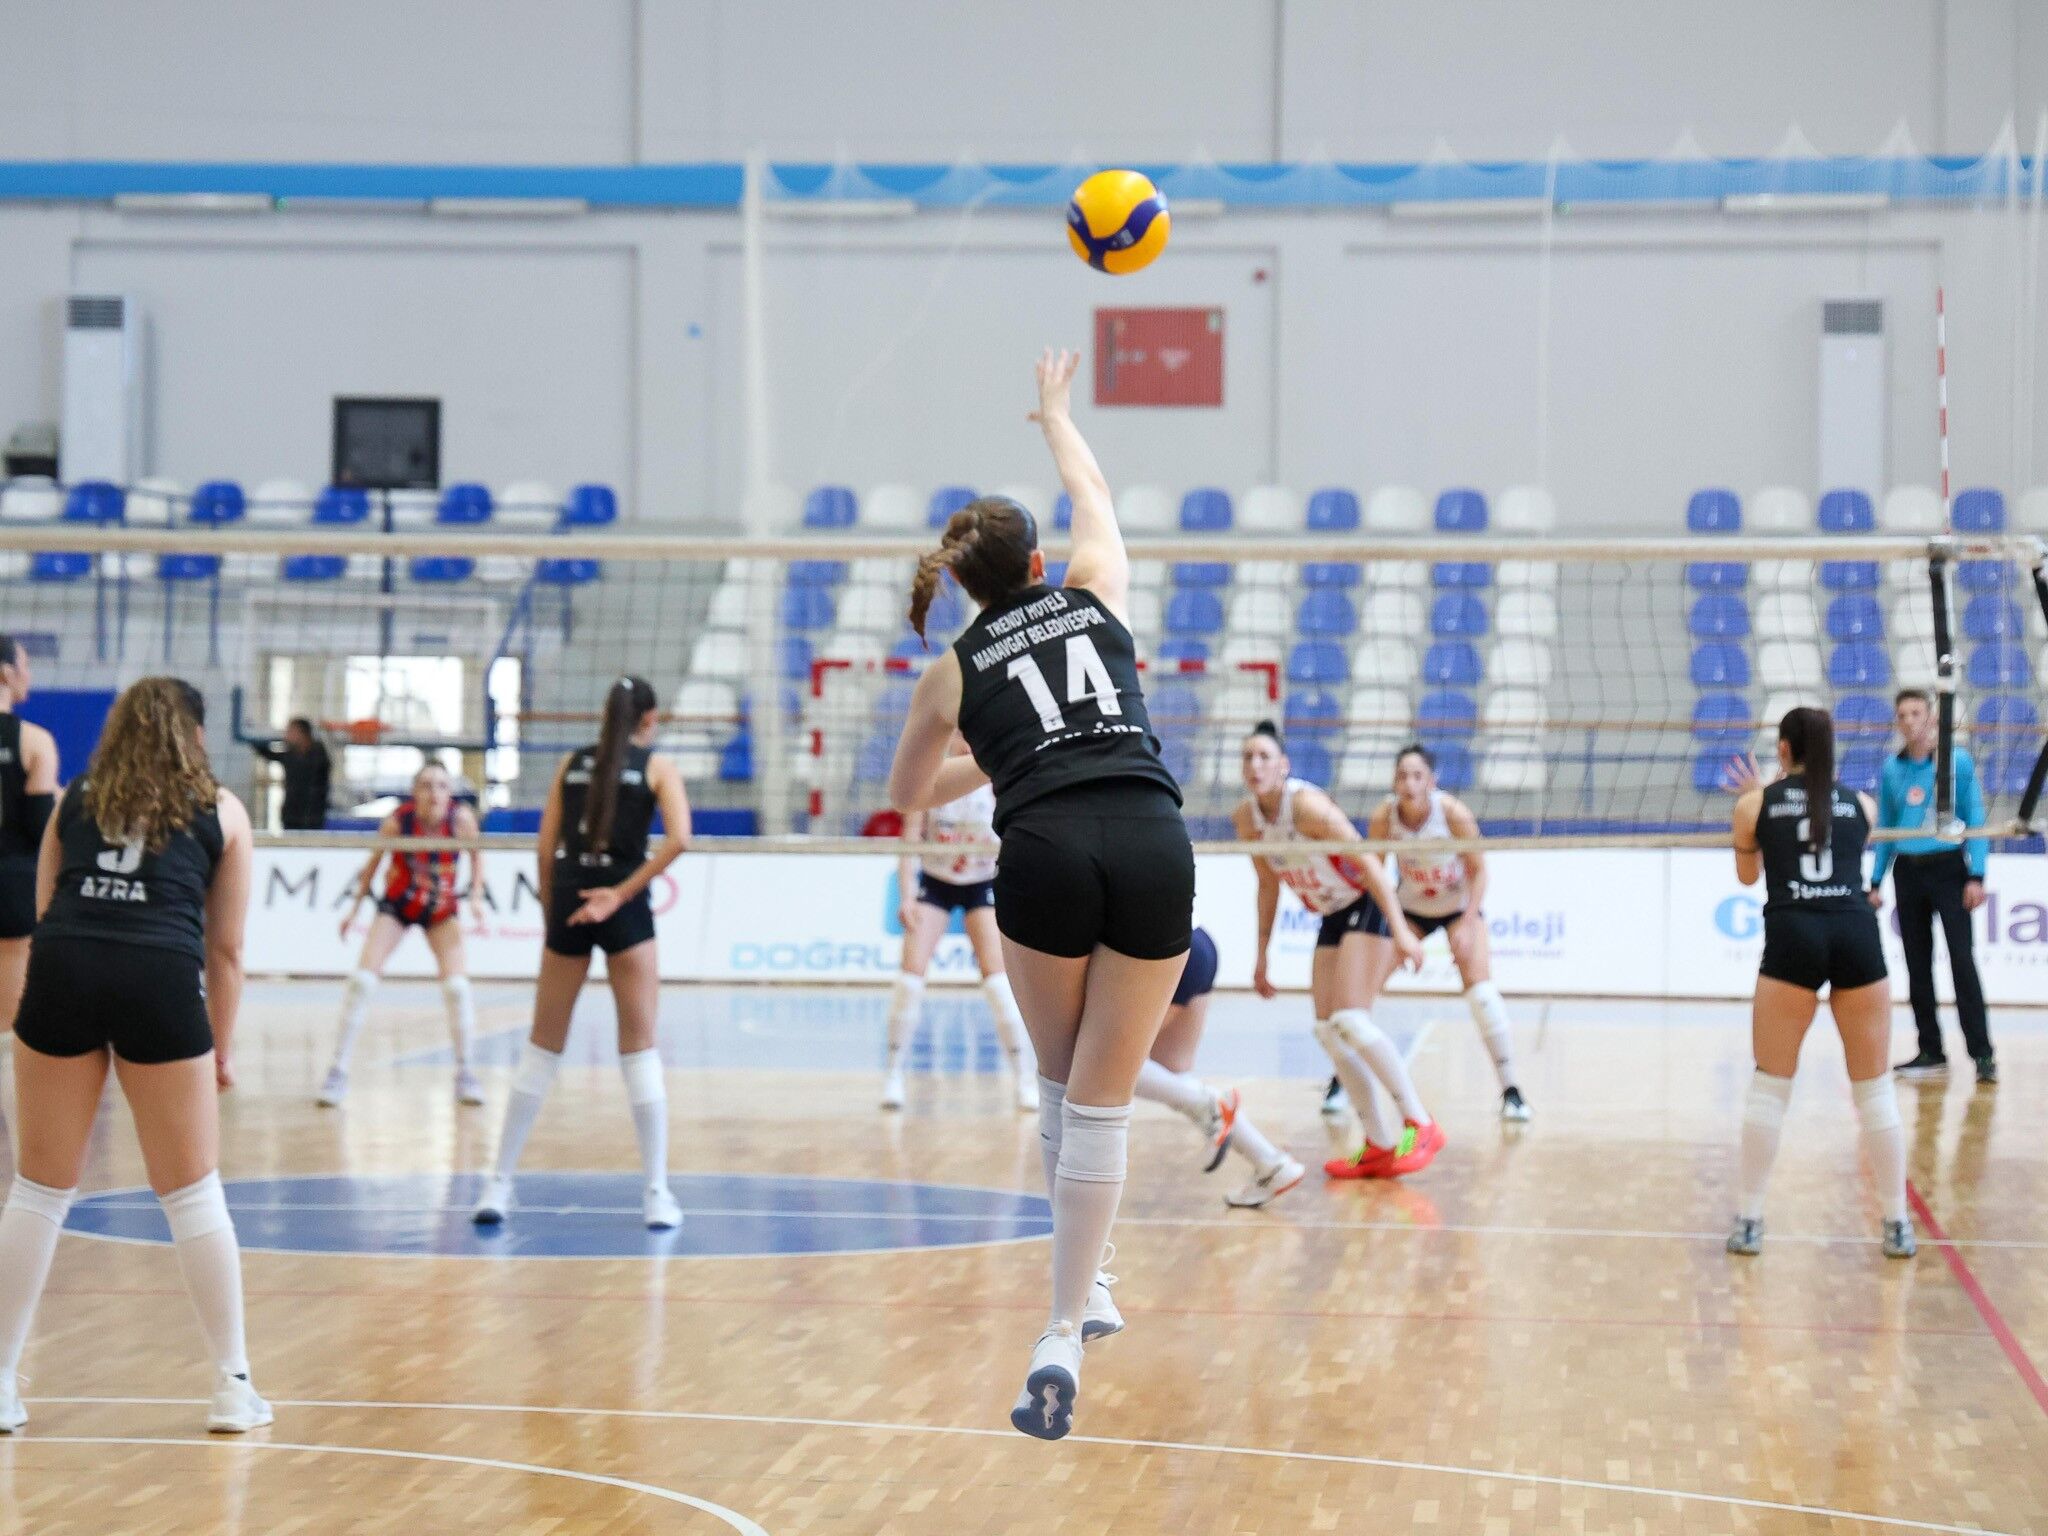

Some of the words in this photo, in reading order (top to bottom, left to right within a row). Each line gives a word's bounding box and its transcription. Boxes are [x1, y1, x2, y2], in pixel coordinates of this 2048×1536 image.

[985, 606, 1028, 638] TRENDY
[1023, 590, 1068, 620] HOTELS
[971, 630, 1030, 672] MANAVGAT
[1006, 634, 1123, 733] 14
[79, 876, 147, 902] AZRA
